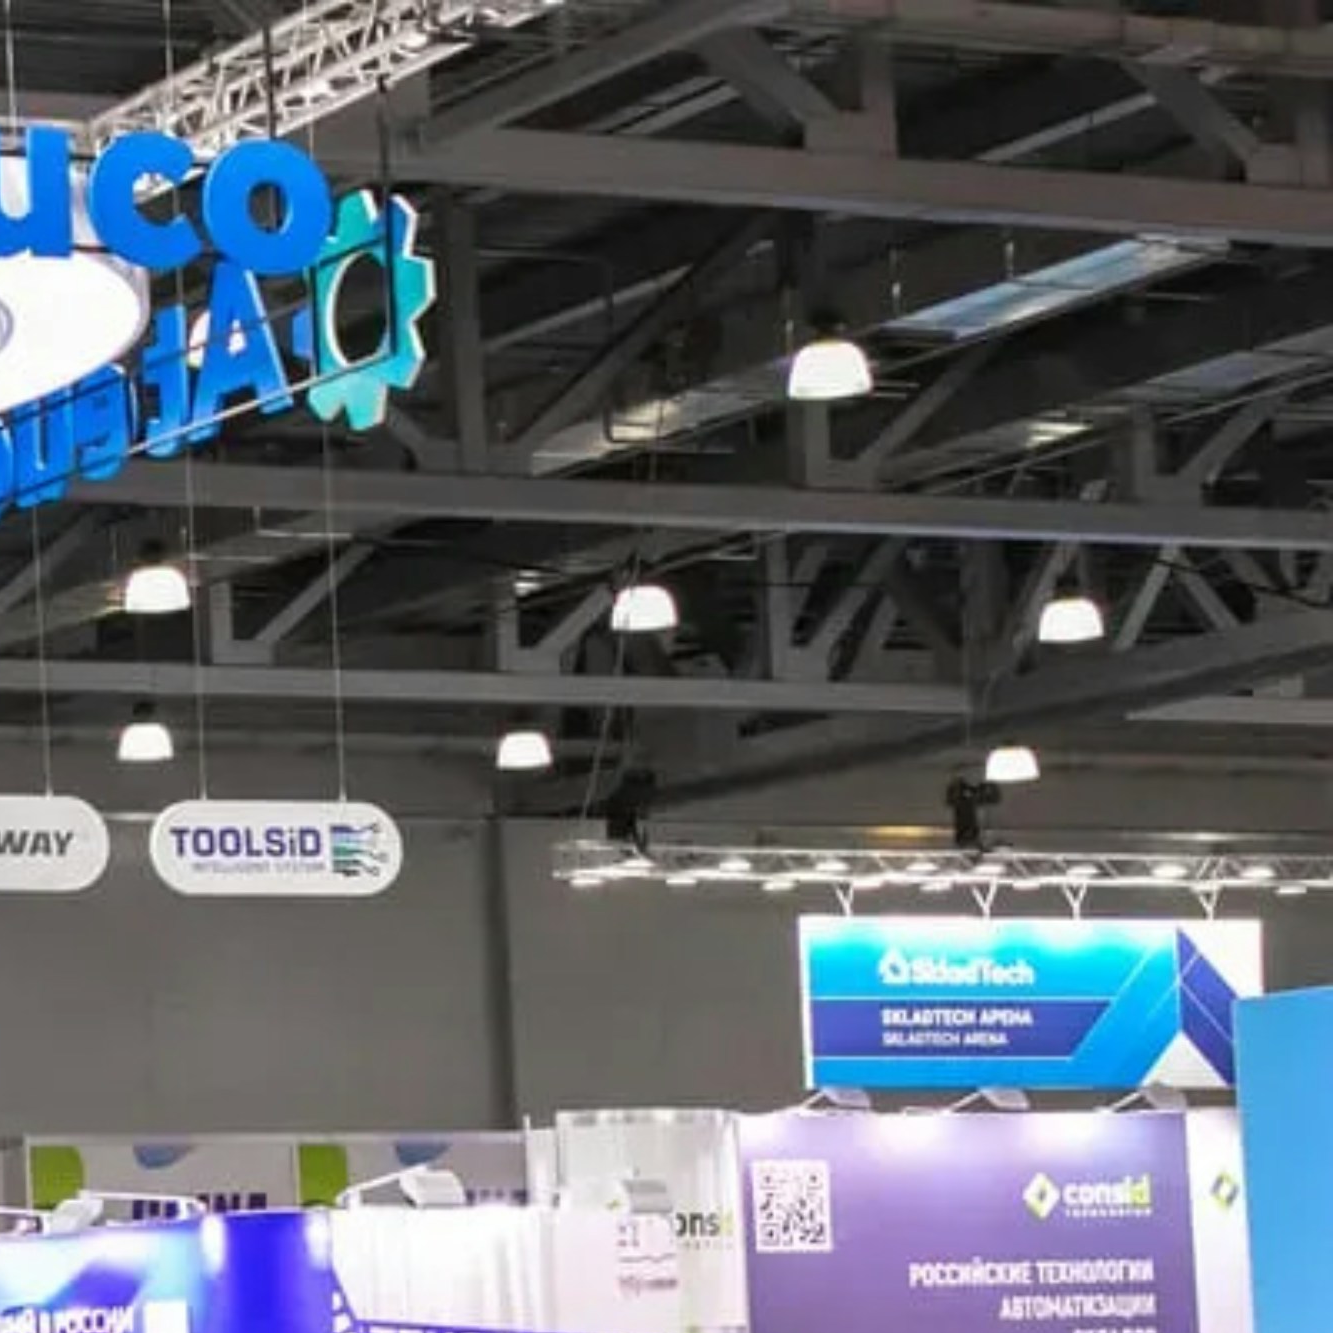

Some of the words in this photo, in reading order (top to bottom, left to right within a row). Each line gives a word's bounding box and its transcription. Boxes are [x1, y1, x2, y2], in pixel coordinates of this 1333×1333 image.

[170, 827, 322, 857] TOOLSiD
[1062, 1174, 1151, 1205] consid
[908, 1256, 1032, 1288] РОССИЙСКИЕ
[1036, 1259, 1155, 1284] ТЕХНОЛОГИИ
[999, 1294, 1157, 1320] АВТОМАТИЗАЦИИ
